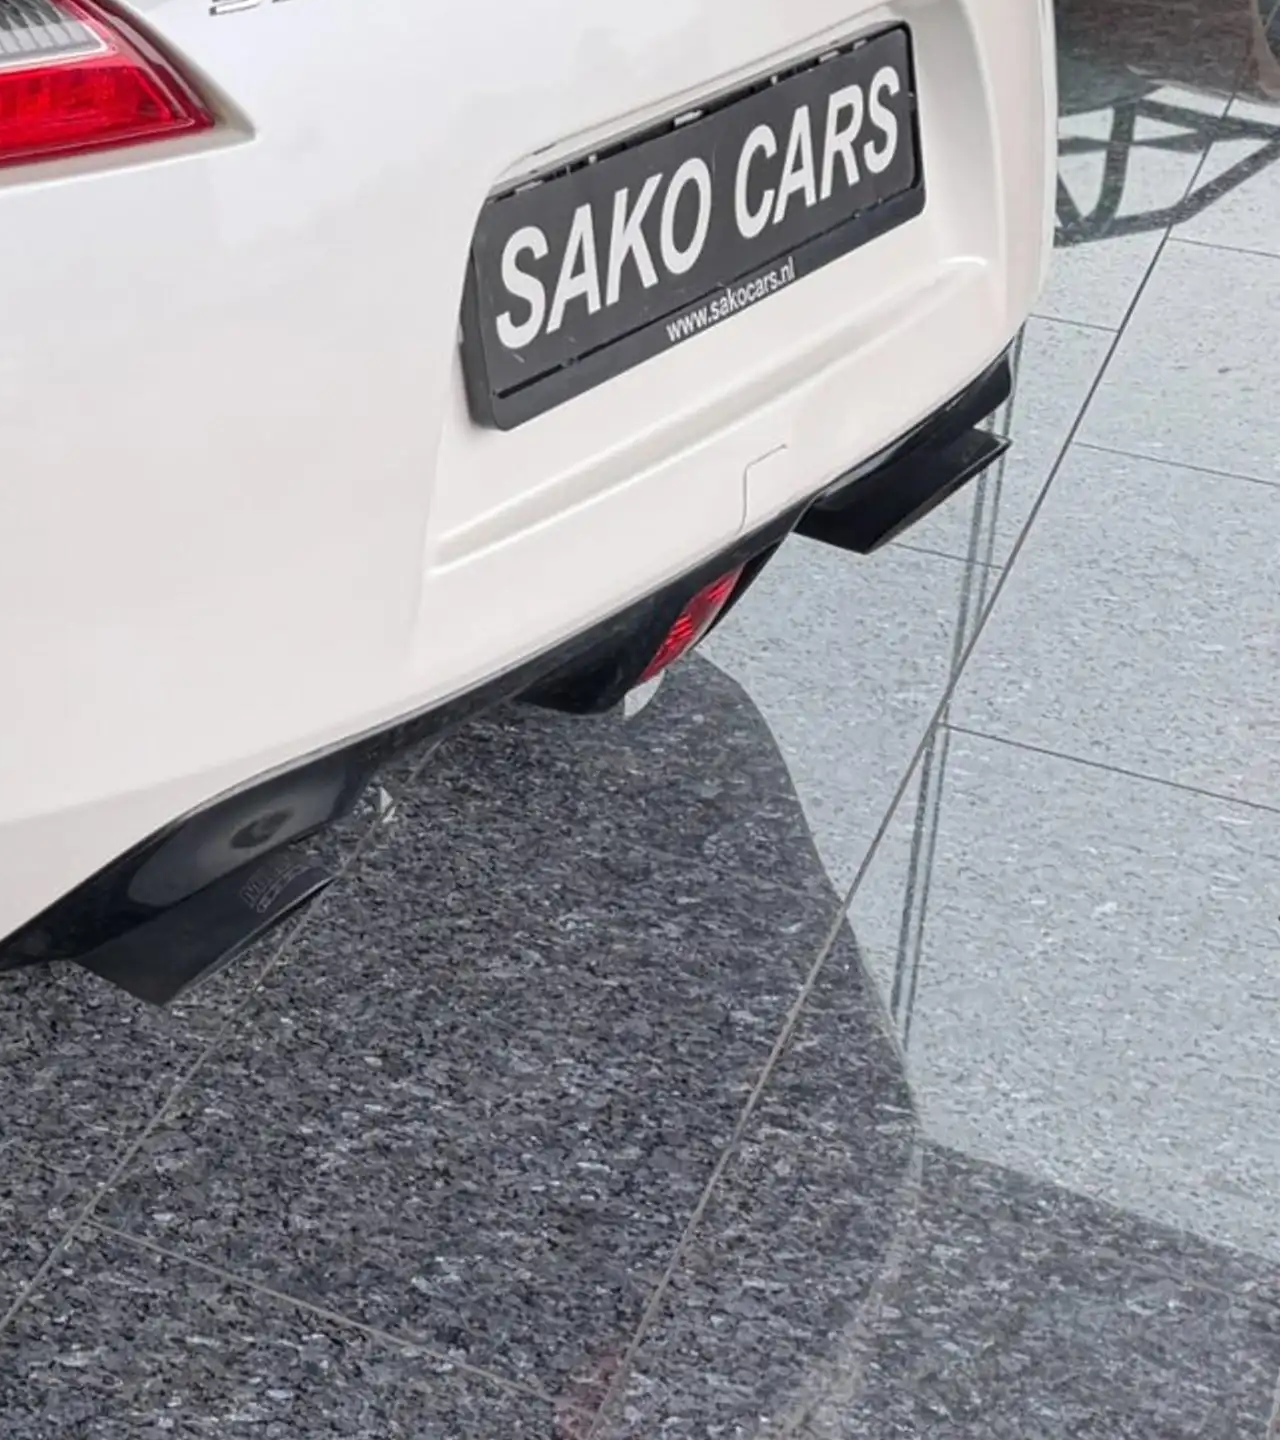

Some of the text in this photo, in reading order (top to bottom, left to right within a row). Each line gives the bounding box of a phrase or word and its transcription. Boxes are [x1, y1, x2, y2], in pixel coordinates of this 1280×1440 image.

[495, 65, 900, 350] SAKO CARS
[665, 255, 796, 343] www.sakocars.nl
